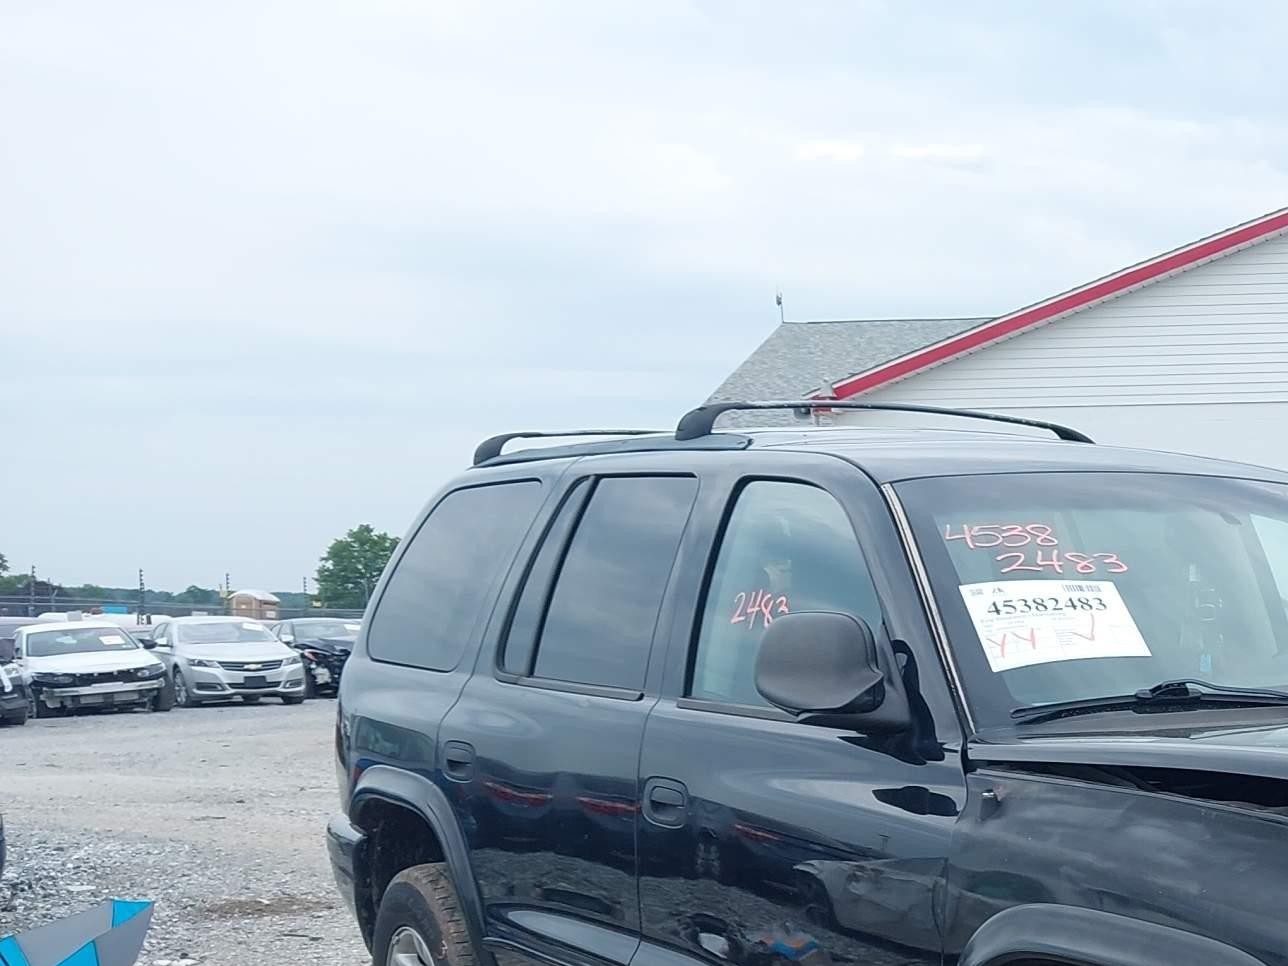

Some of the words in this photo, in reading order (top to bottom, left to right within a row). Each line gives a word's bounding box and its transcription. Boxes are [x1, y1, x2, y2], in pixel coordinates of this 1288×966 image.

[945, 524, 1058, 549] 4538
[996, 549, 1129, 574] 2483
[987, 596, 1108, 616] 45382483
